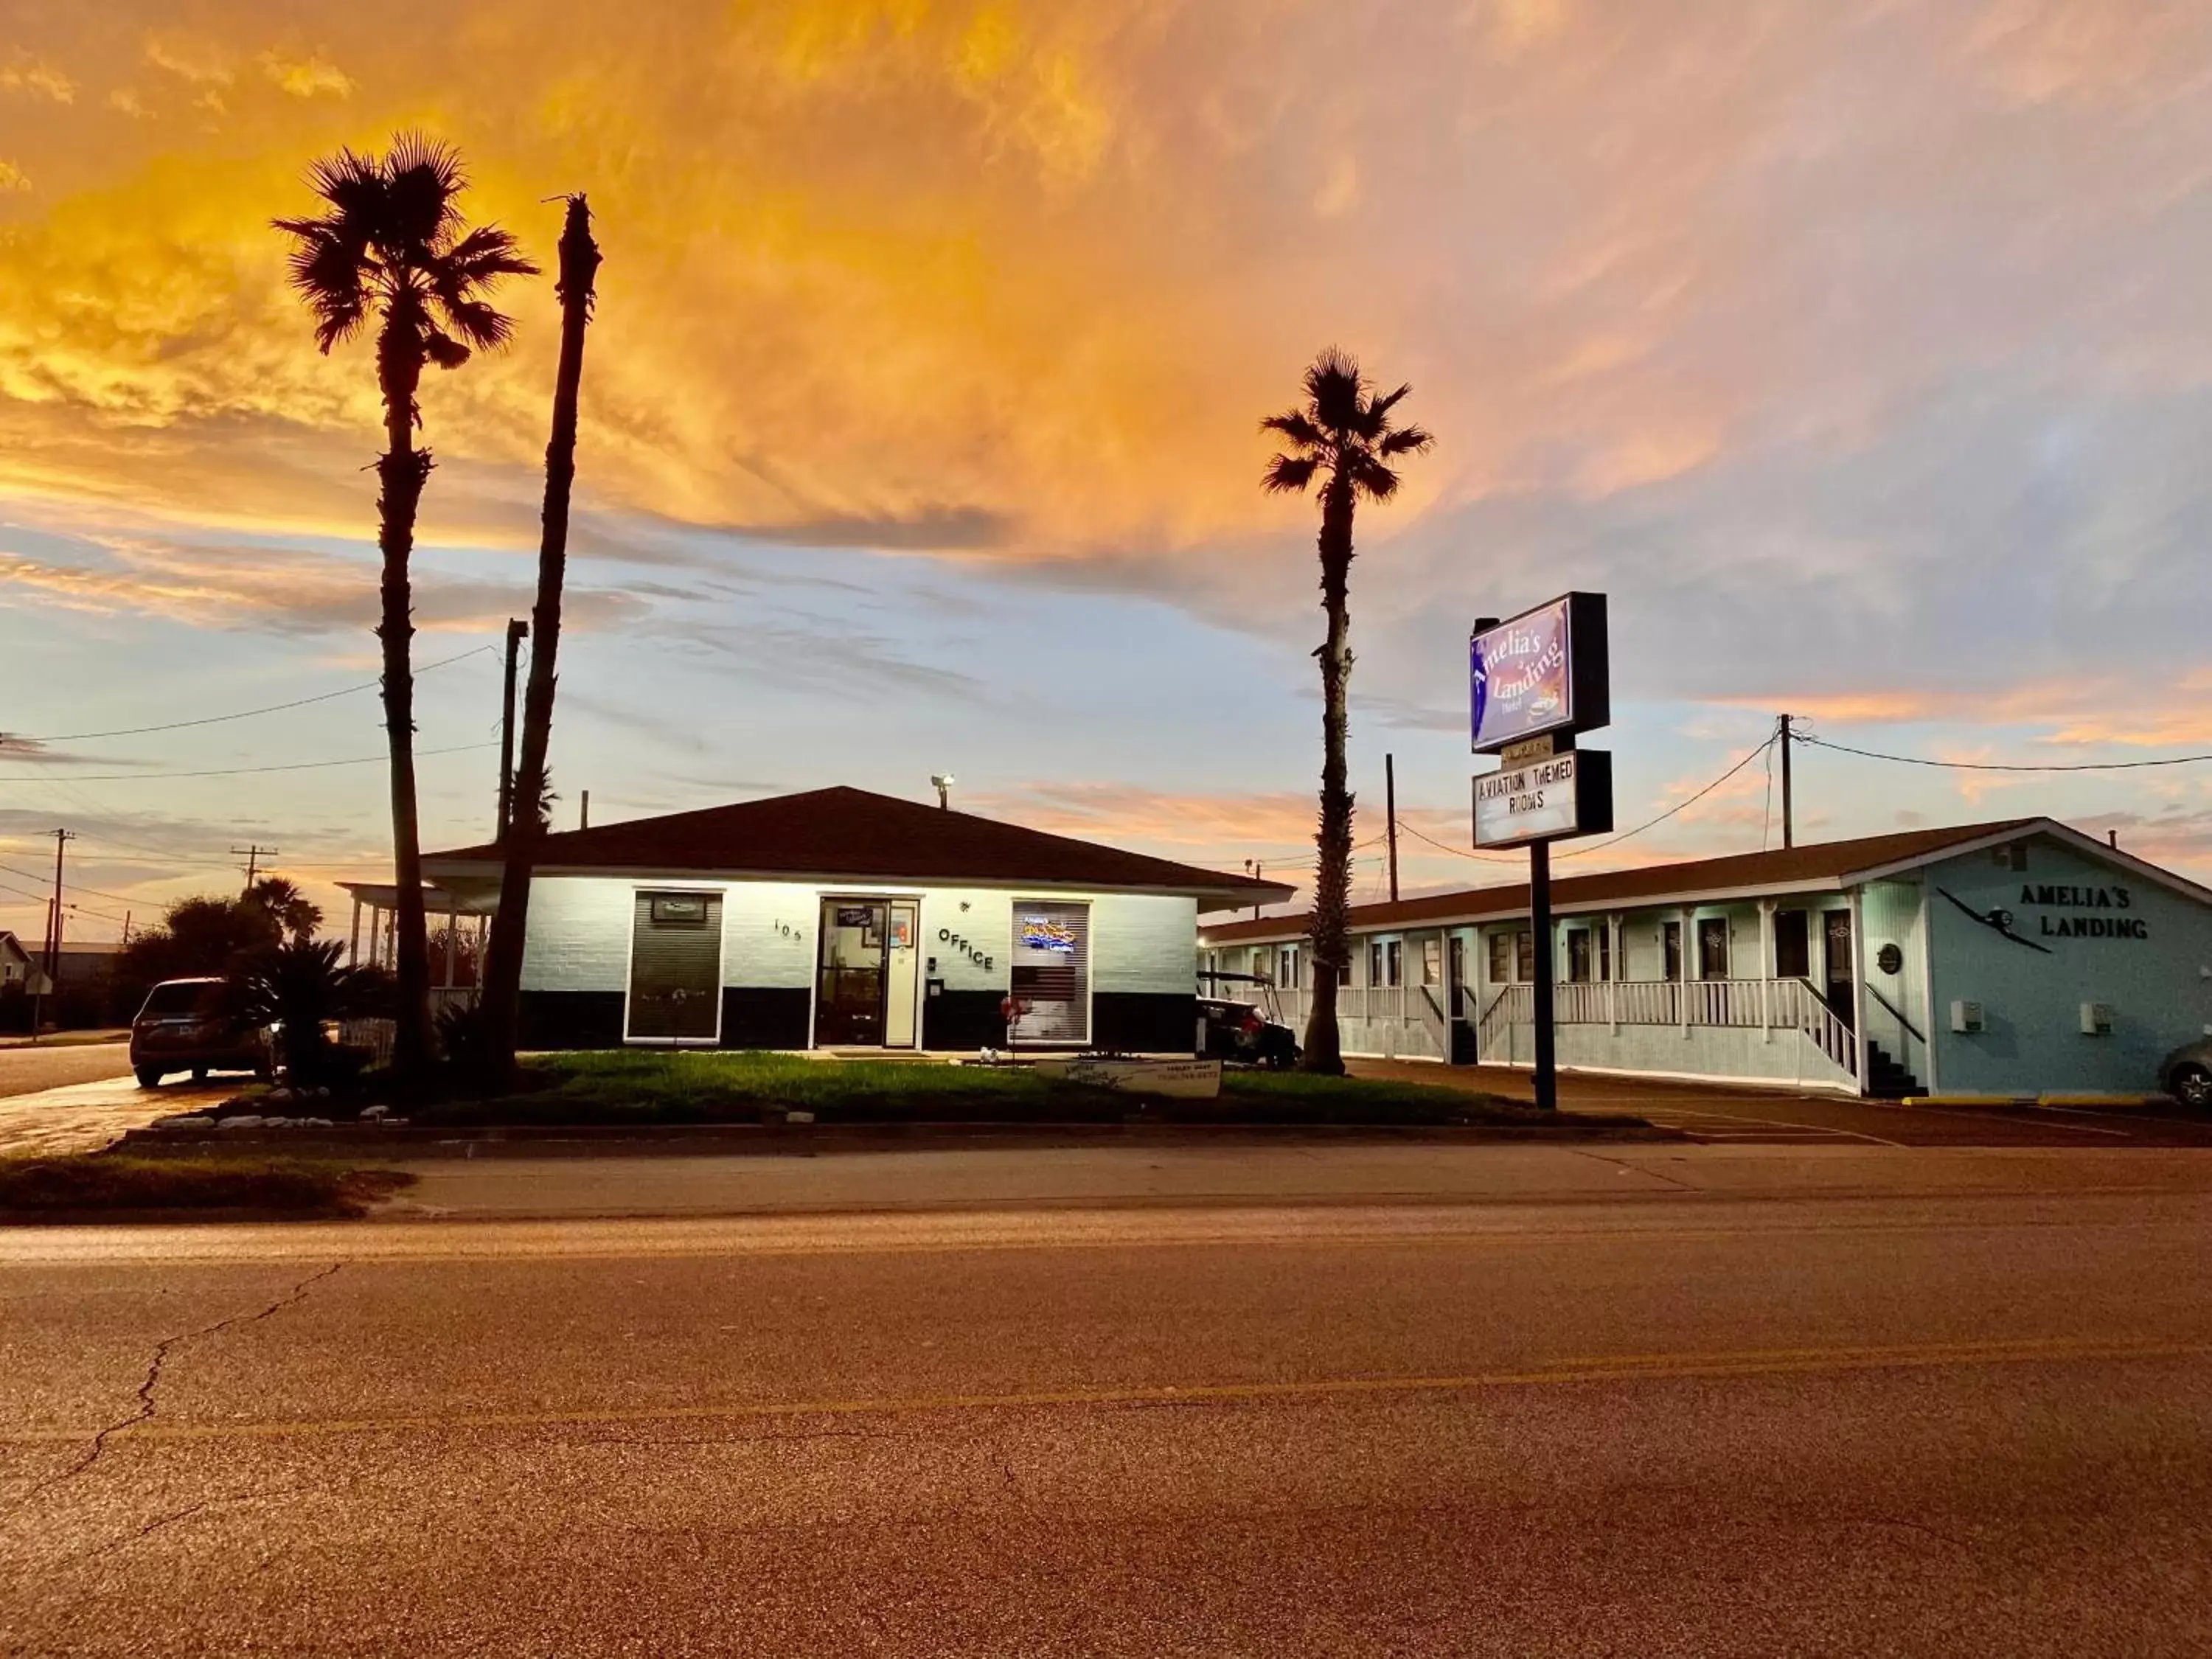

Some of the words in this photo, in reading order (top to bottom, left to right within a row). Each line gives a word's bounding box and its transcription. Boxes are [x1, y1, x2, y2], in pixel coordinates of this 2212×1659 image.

[1474, 629, 1540, 695] Amelia's
[1479, 772, 1526, 801] AVIATION
[1533, 760, 1573, 786] THEMED
[1509, 790, 1543, 814] ROOMS
[2021, 885, 2129, 908] AMELIA'S
[774, 919, 801, 941] 105
[2040, 915, 2148, 939] LANDING
[939, 928, 993, 970] OFFICE
